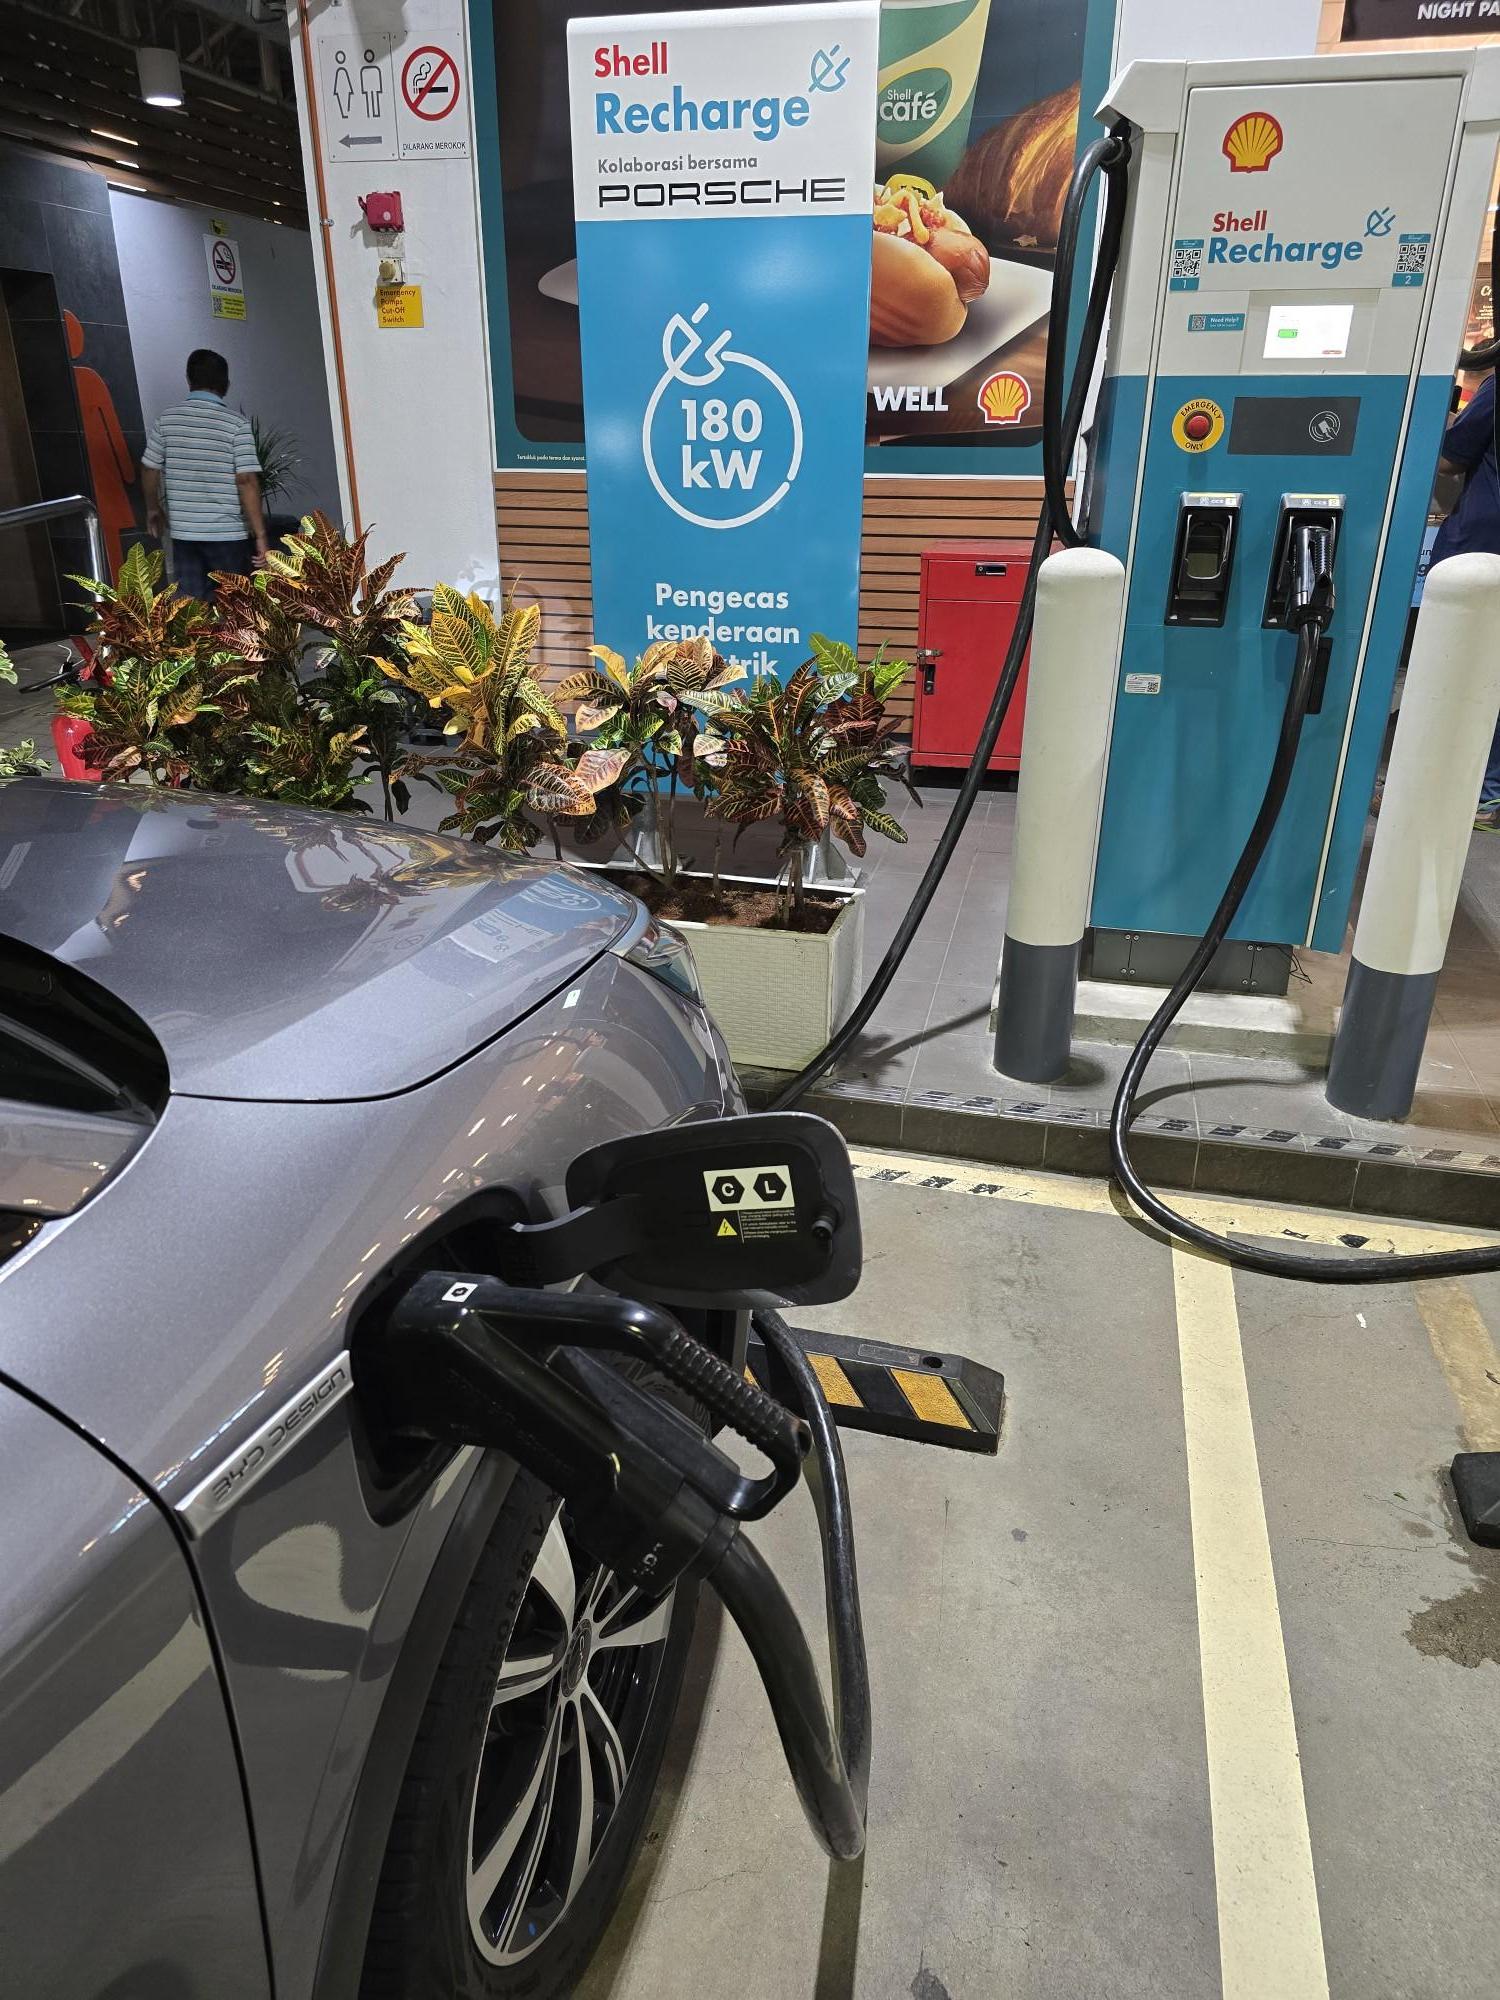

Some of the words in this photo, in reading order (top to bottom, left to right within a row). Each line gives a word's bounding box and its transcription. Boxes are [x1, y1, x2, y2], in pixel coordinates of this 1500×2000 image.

[1417, 1, 1475, 20] NIGHT
[594, 41, 668, 78] Shell
[879, 91, 938, 122] café
[887, 89, 912, 101] Shell
[595, 85, 810, 142] Recharge
[435, 142, 466, 150] MEROKOK
[598, 155, 684, 174] Kolaborasi
[687, 154, 758, 171] bersama
[598, 177, 846, 208] PORSCHE
[1212, 210, 1268, 233] Shell
[1208, 234, 1363, 270] Recharge
[1404, 275, 1412, 285] 2
[379, 289, 416, 297] Emergency
[381, 298, 403, 306] Pumps
[872, 385, 949, 412] WELL
[1181, 401, 1223, 419] EMERGENCY
[681, 398, 763, 443] 180
[1185, 442, 1204, 450] ONLY
[682, 444, 763, 490] kW
[655, 582, 788, 615] Pengecas
[646, 615, 800, 645] kenderaan
[722, 1183, 735, 1197] C
[764, 1181, 777, 1194] L
[211, 1445, 265, 1503] BYD
[268, 1367, 347, 1446] DESIGN
